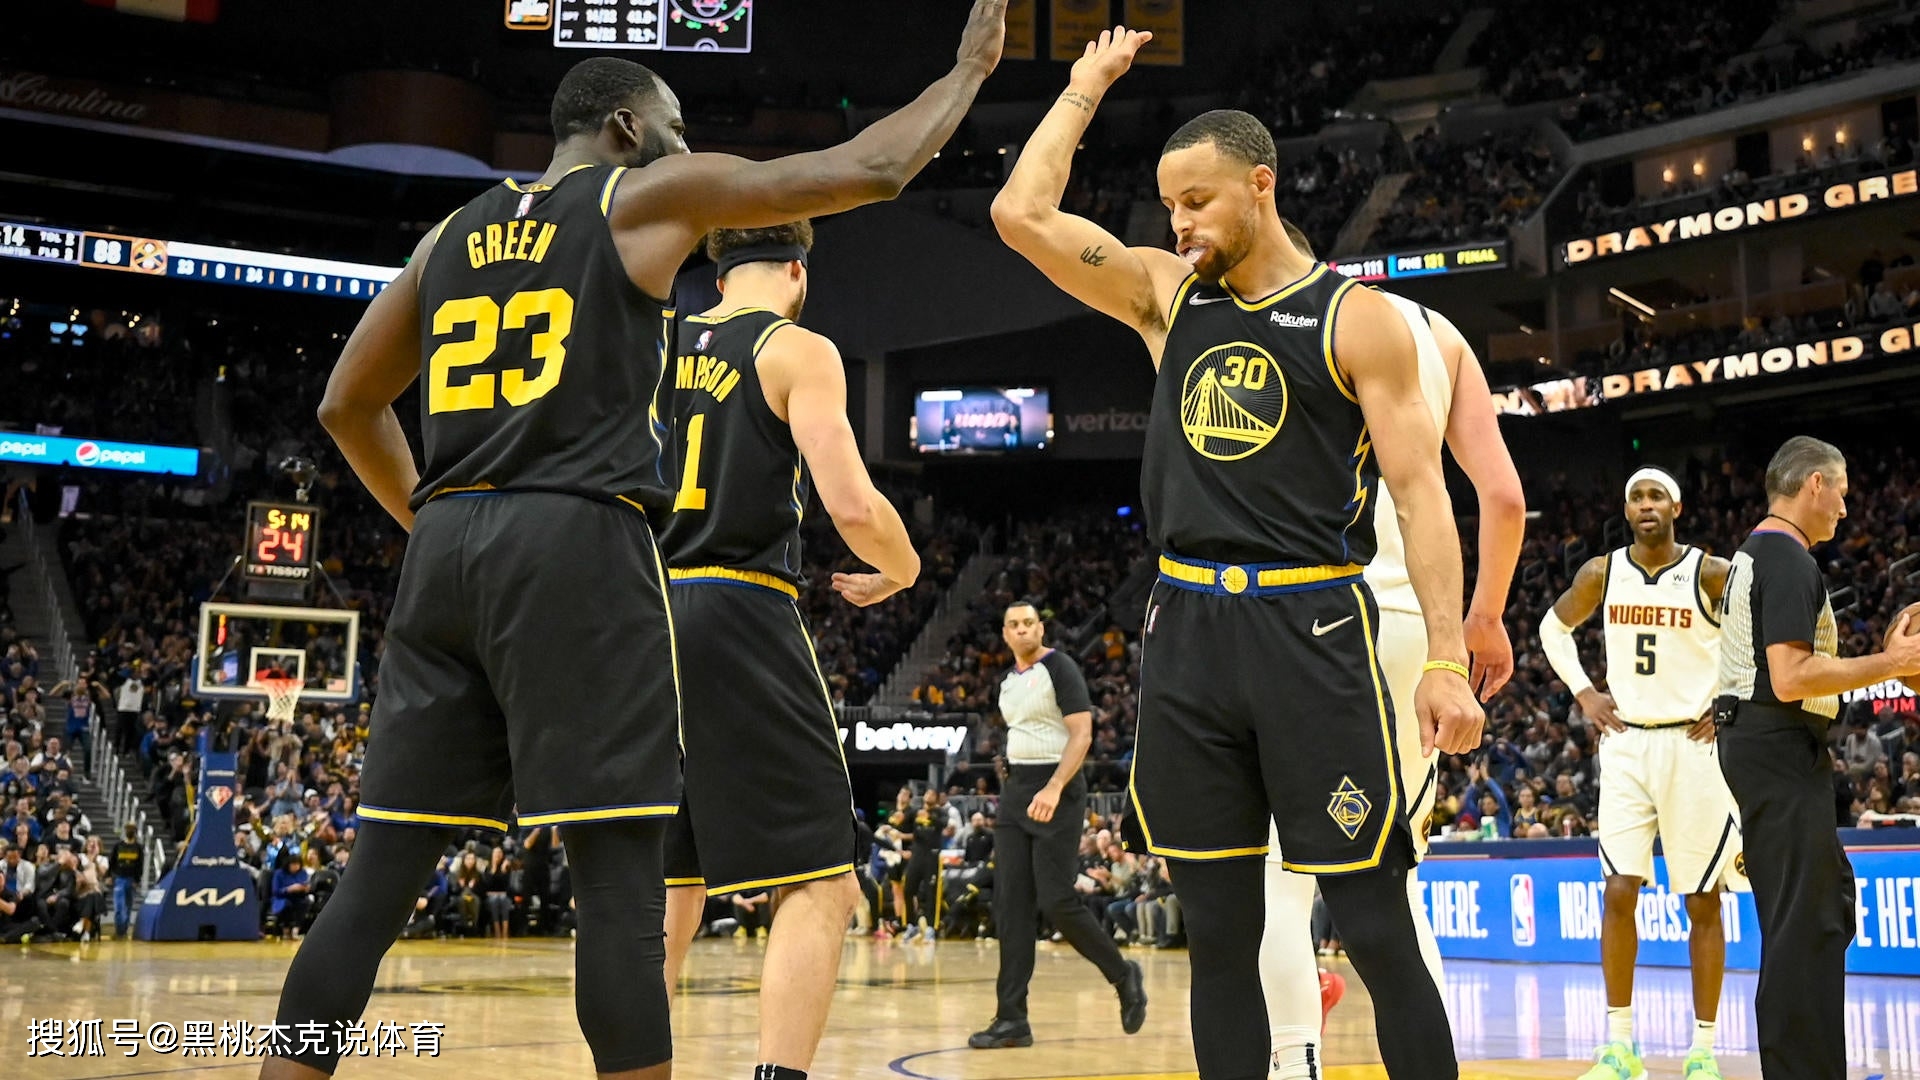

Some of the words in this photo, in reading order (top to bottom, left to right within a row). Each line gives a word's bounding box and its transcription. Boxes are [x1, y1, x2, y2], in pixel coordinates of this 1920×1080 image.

[467, 219, 558, 269] GREEN
[1566, 193, 1809, 263] DRAYMOND
[1457, 248, 1498, 265] FINAL
[1270, 310, 1318, 327] Rakuten
[429, 287, 574, 415] 23
[1602, 336, 1864, 399] DRAYMOND
[675, 355, 741, 403] MPSON
[1220, 355, 1268, 390] 30
[1065, 407, 1149, 432] verizo
[100, 449, 146, 465] pepsi
[258, 528, 303, 562] 24
[265, 565, 310, 578] TISSOT
[1608, 604, 1692, 629] NUGGETS
[1635, 633, 1656, 676] 5
[855, 721, 967, 754] betway
[1431, 880, 1488, 939] HERE.
